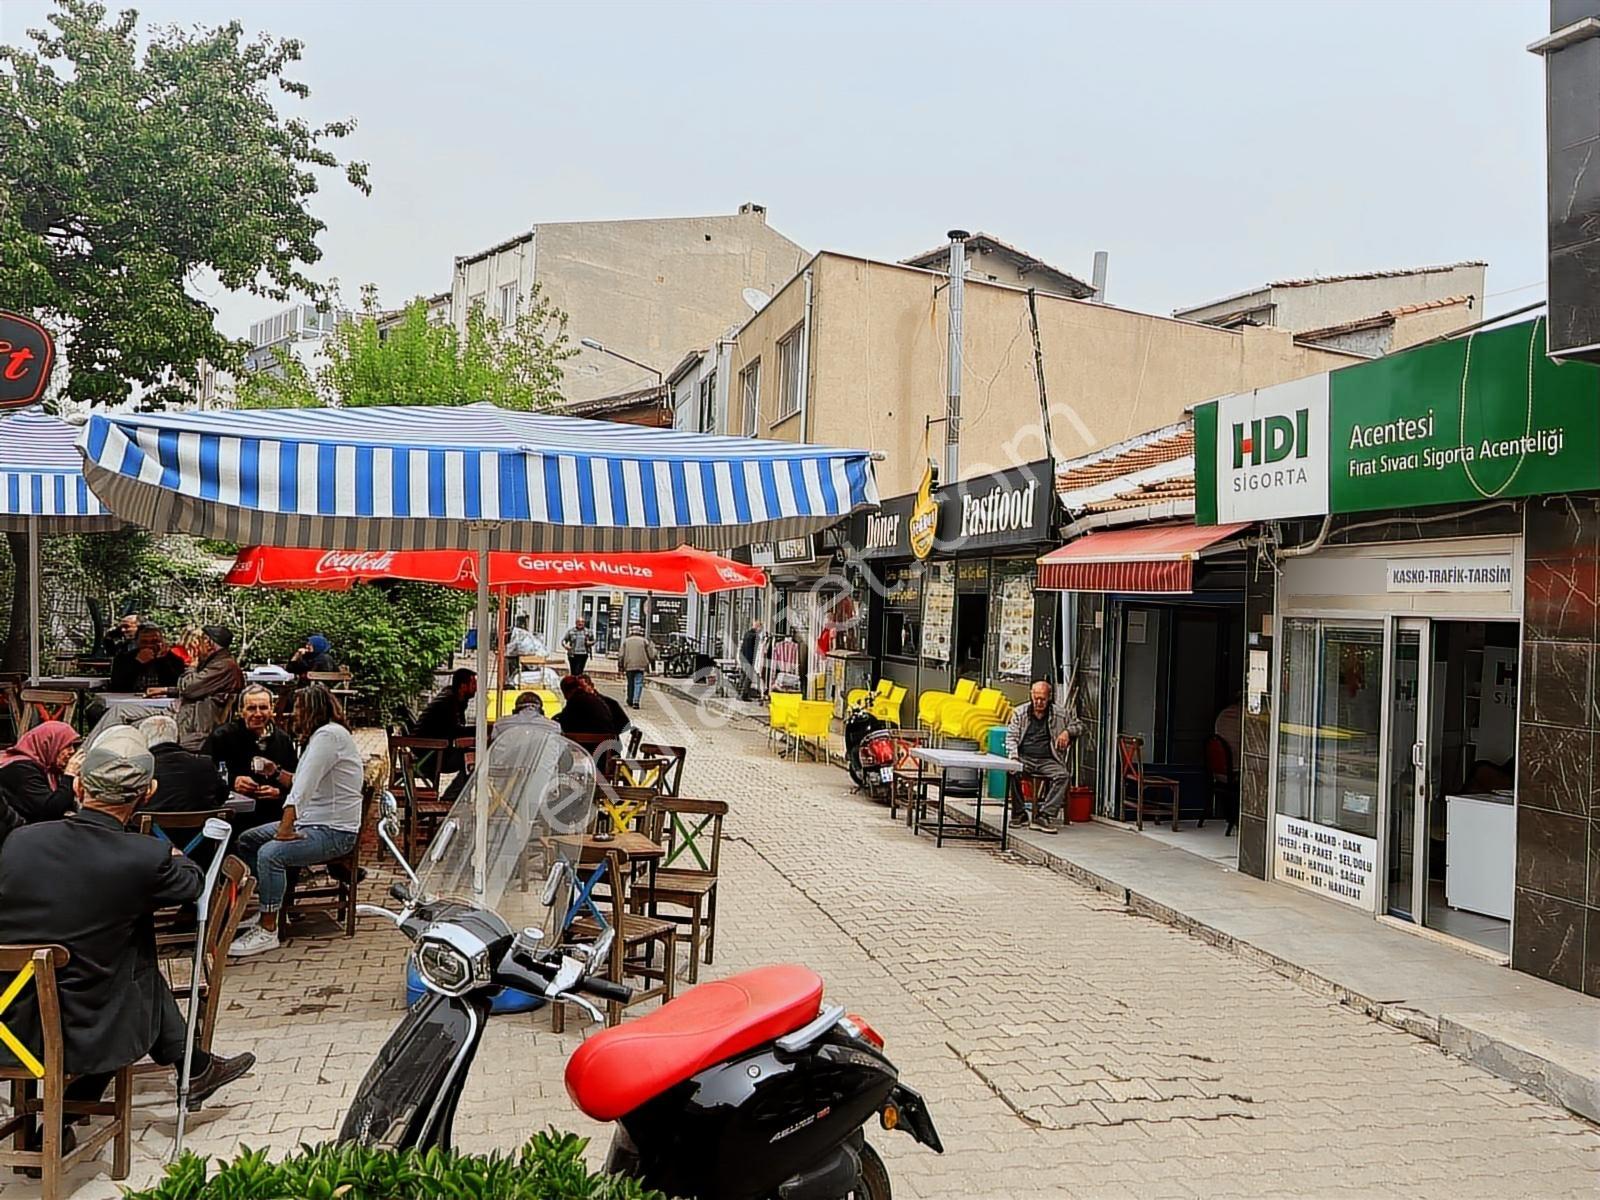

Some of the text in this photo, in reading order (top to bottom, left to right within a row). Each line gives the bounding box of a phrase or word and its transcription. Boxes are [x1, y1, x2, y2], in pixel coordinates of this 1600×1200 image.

[1232, 408, 1309, 469] HDI
[1349, 409, 1434, 449] Acentesi
[1349, 428, 1564, 477] Fırat Sıvacı Sigorta Acenteliği
[1233, 467, 1308, 492] SİGORTA
[960, 480, 1036, 537] Fastfood
[866, 510, 900, 549] Döner
[517, 555, 653, 578] Gerçek Mucize
